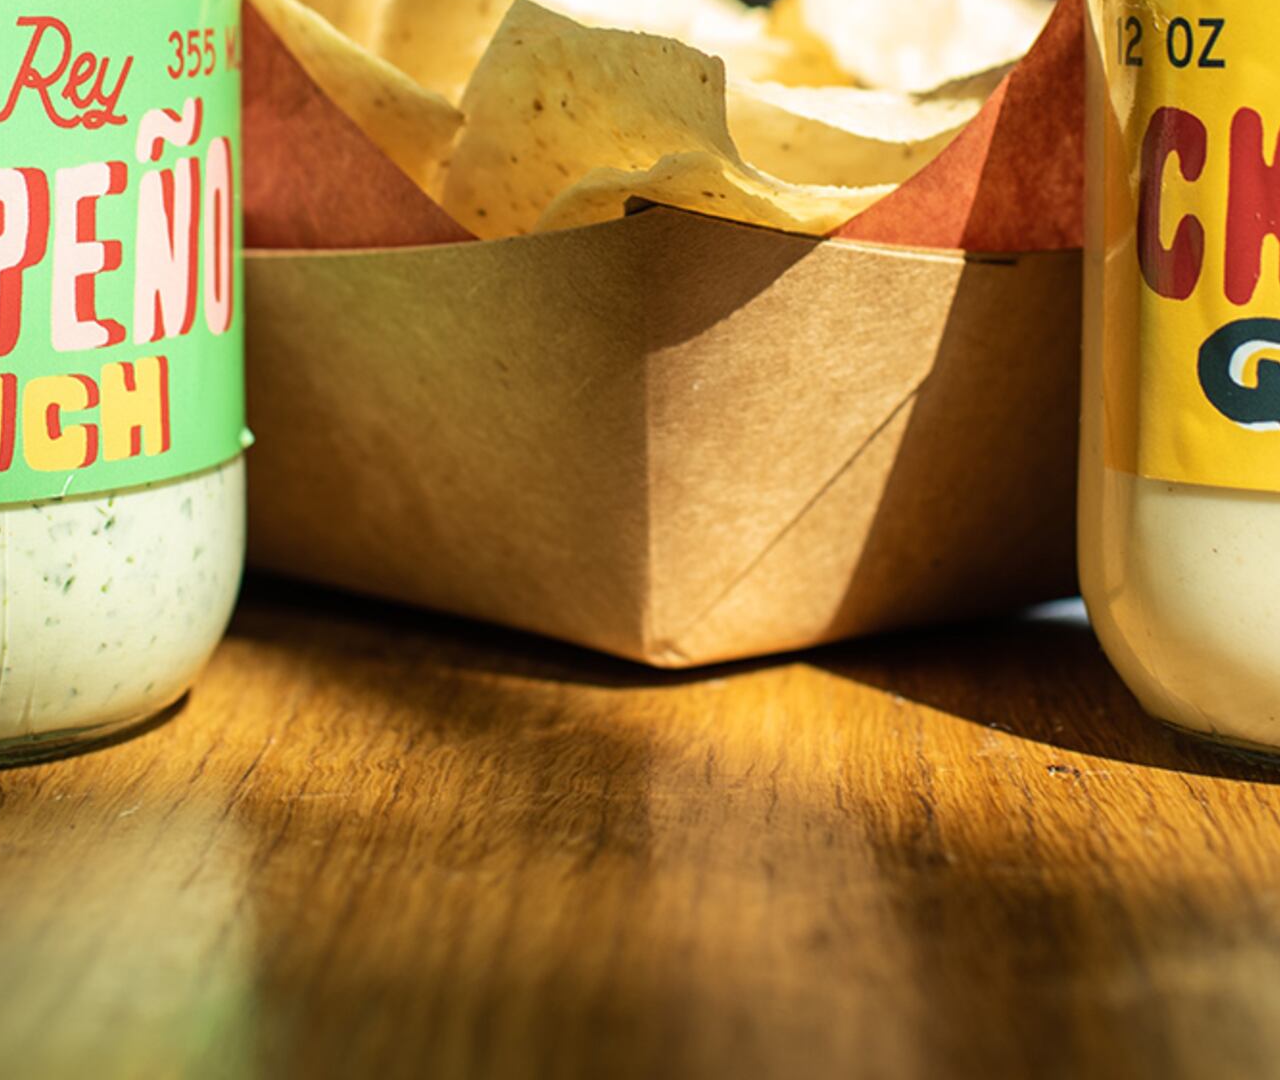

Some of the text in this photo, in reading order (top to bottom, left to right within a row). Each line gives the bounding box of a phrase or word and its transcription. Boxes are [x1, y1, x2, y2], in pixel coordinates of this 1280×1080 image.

[167, 27, 217, 80] 355
[1117, 15, 1225, 69] 12 OZ
